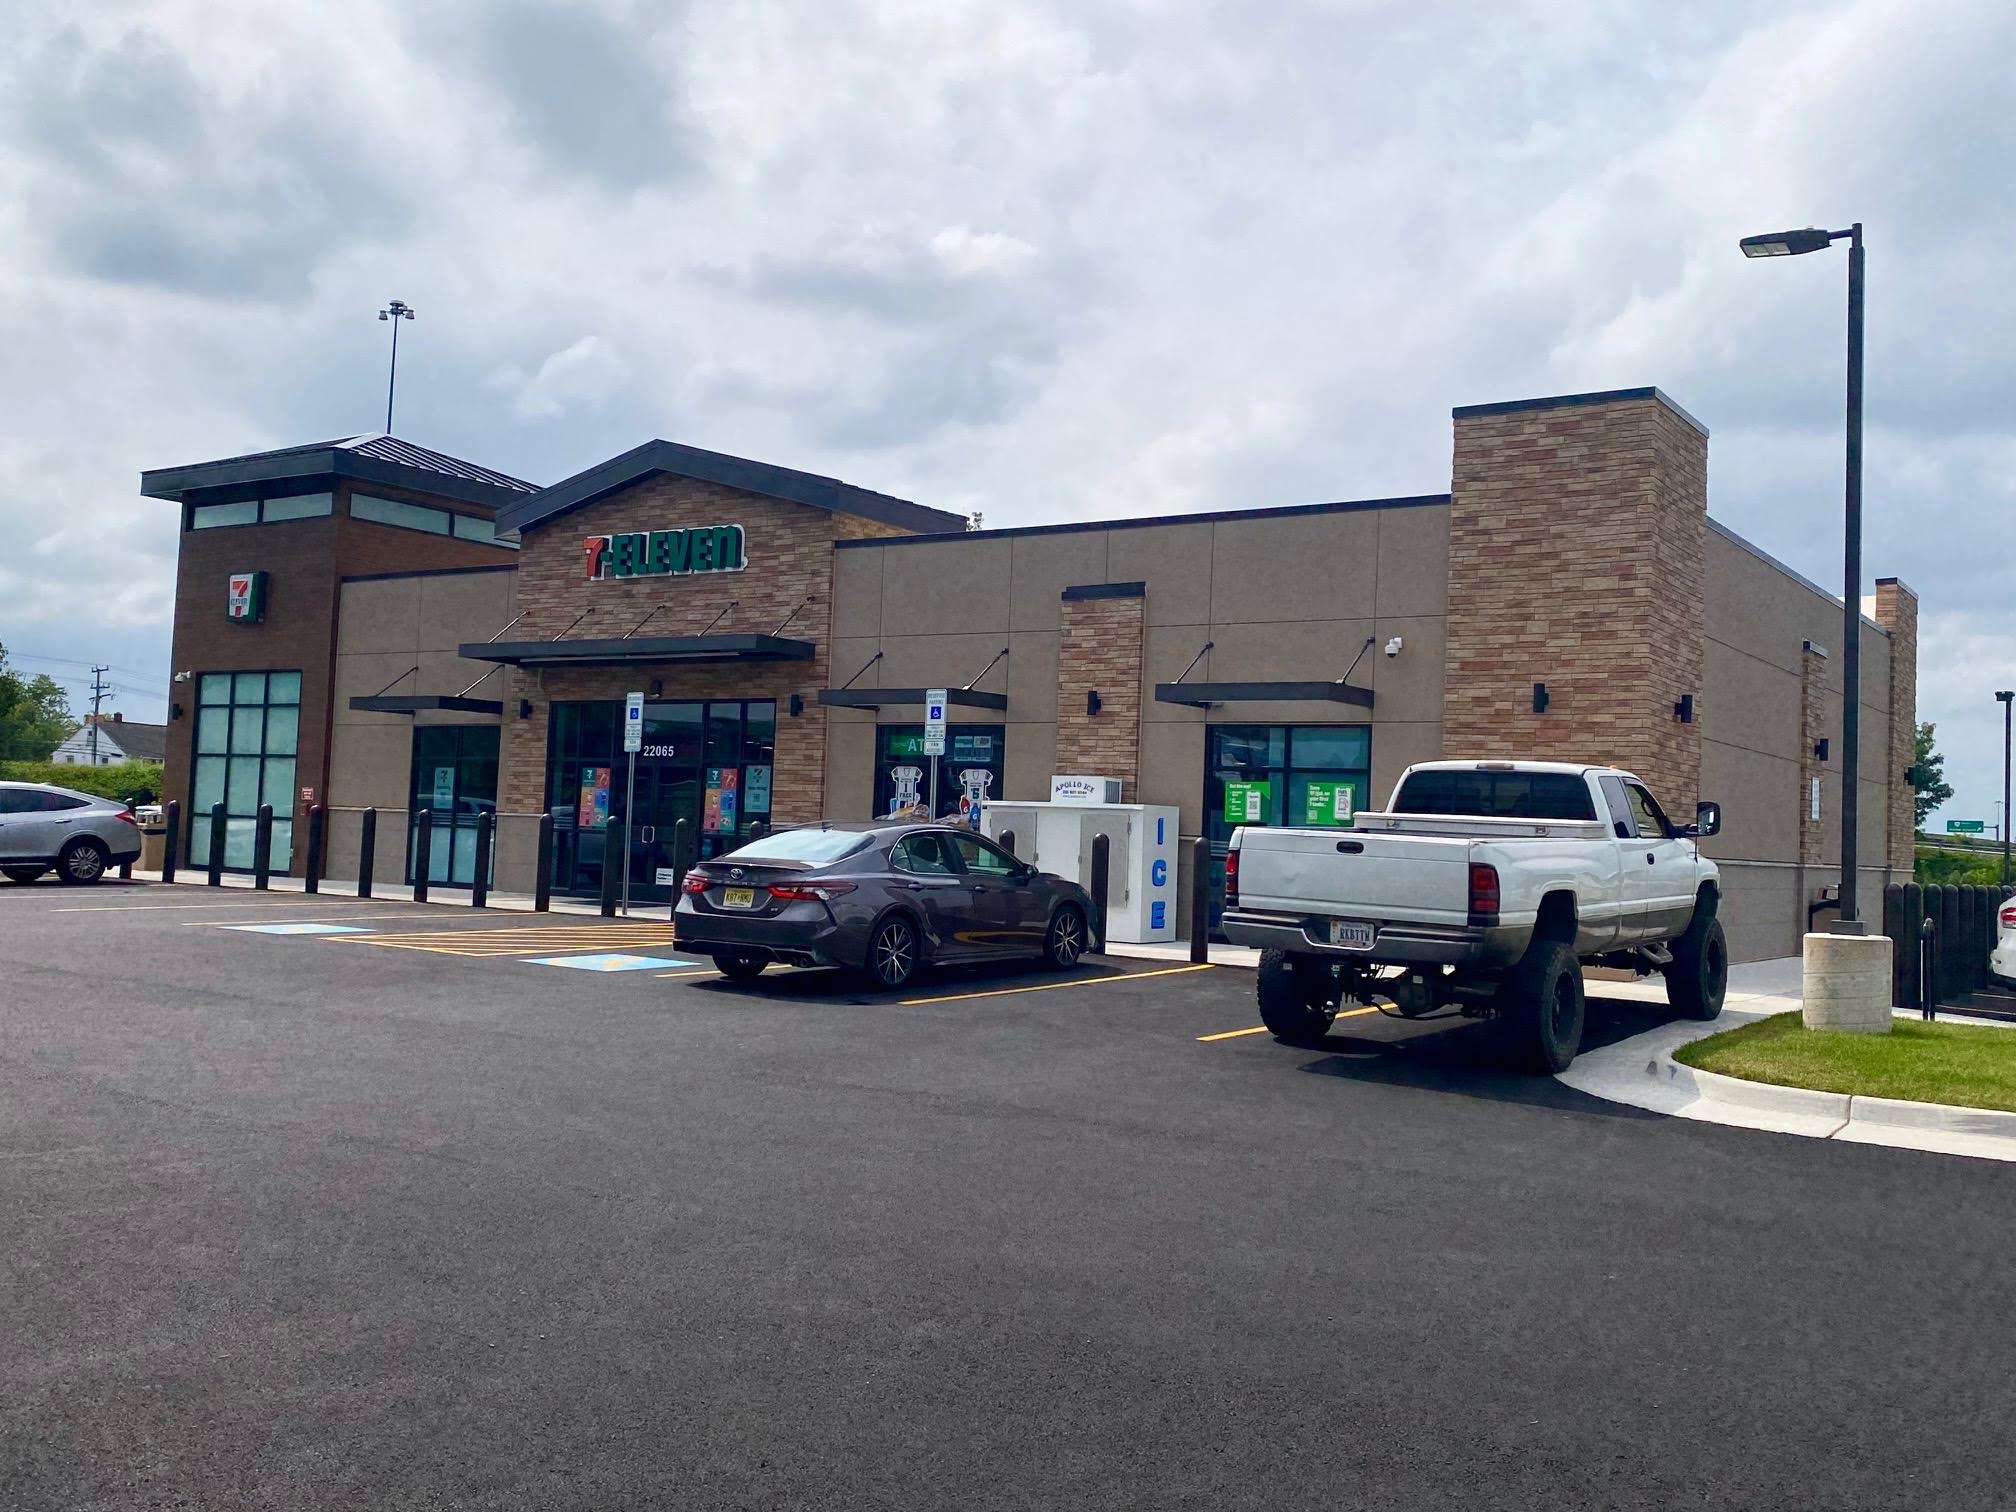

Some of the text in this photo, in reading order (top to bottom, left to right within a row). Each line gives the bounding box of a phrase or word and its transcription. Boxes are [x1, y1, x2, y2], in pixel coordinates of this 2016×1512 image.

[643, 745, 674, 757] 22065
[1055, 781, 1096, 794] APOLLO ICE
[1150, 817, 1167, 930] ICE
